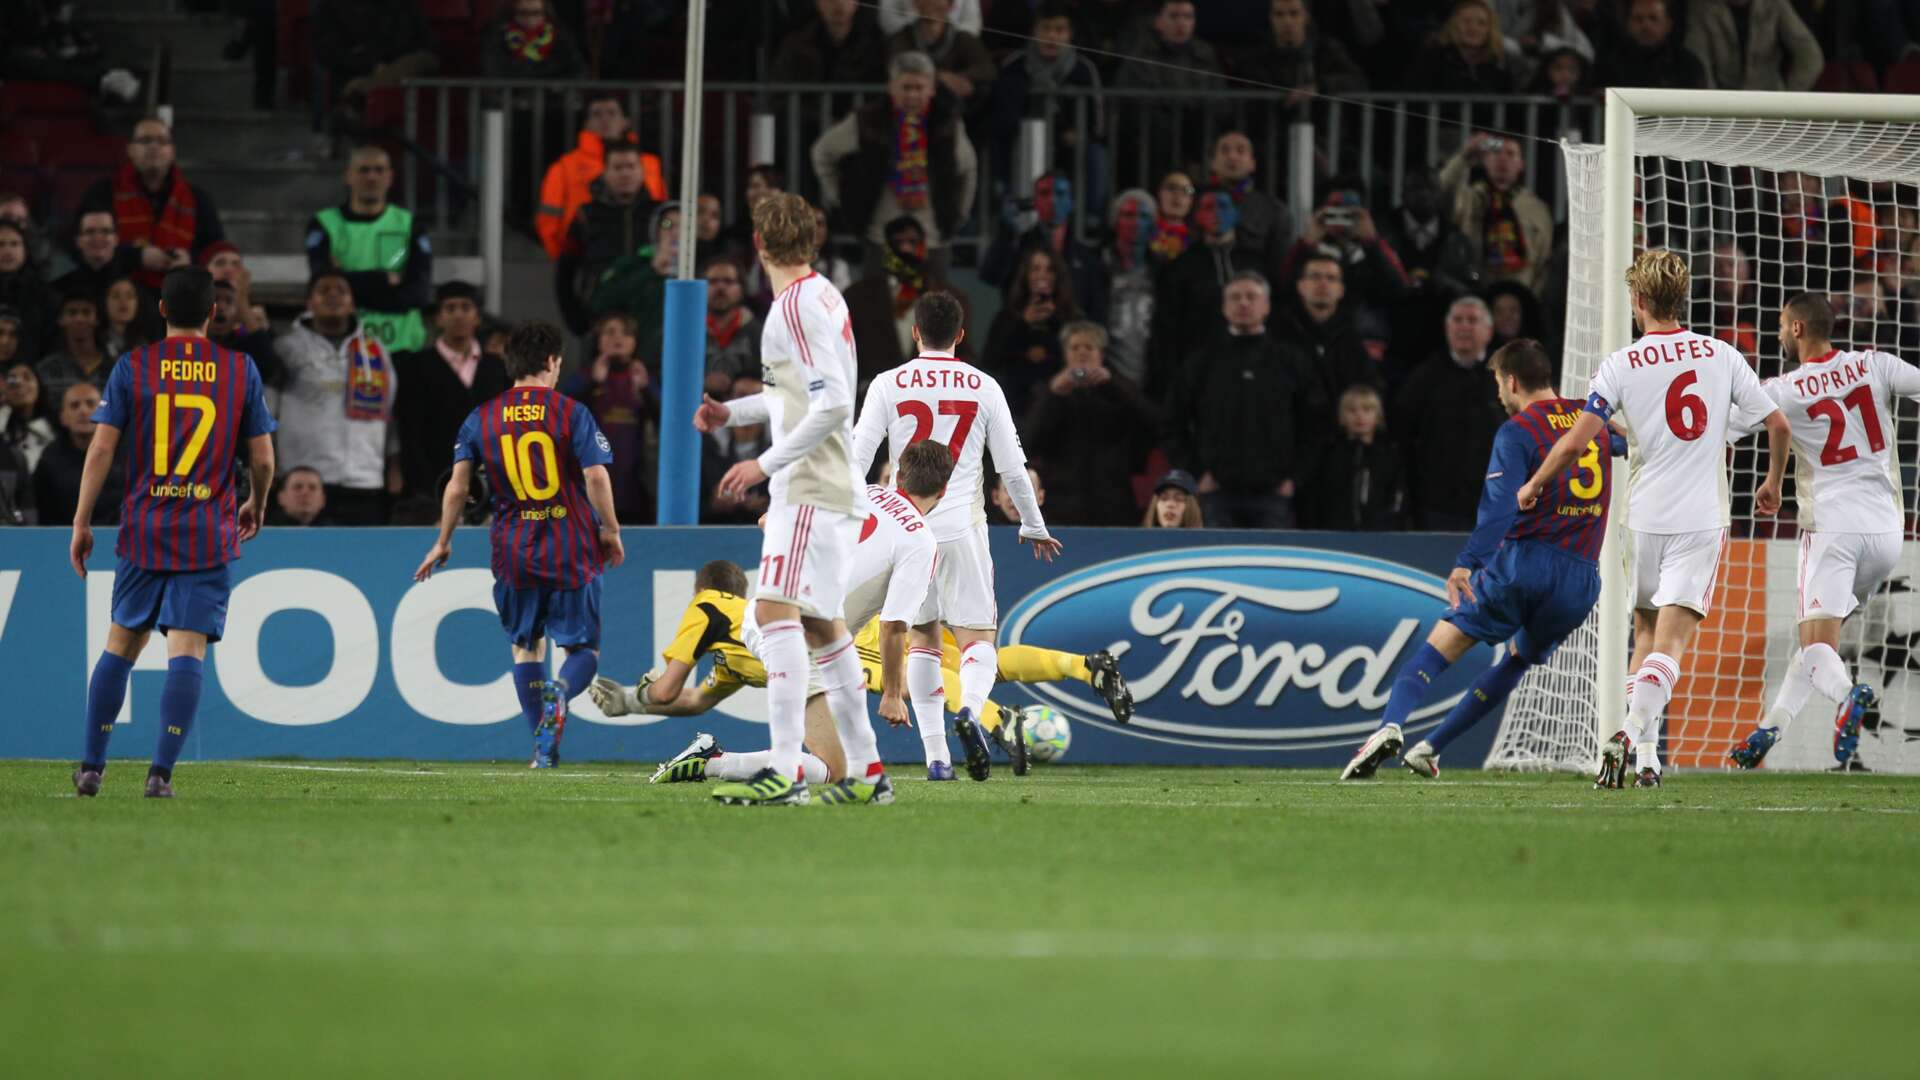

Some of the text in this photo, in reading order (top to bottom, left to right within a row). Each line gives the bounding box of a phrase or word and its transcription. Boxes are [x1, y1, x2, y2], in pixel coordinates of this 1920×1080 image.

[160, 359, 217, 382] PEDRO
[1627, 339, 1714, 369] ROLFES
[896, 369, 982, 390] CASTRO
[1794, 360, 1869, 397] TOPRAK
[503, 405, 545, 422] MESSI
[1547, 408, 1583, 430] PIQU
[1665, 369, 1708, 442] 6
[154, 393, 217, 476] 17
[1806, 384, 1886, 466] 21
[501, 431, 560, 501] 10
[1569, 439, 1603, 500] 3
[150, 481, 193, 498] unicef
[521, 506, 551, 520] unicef
[866, 486, 924, 532] CHWAAB
[761, 554, 785, 587] 11
[86, 567, 769, 726] OCU
[1107, 577, 1421, 710] Ford
